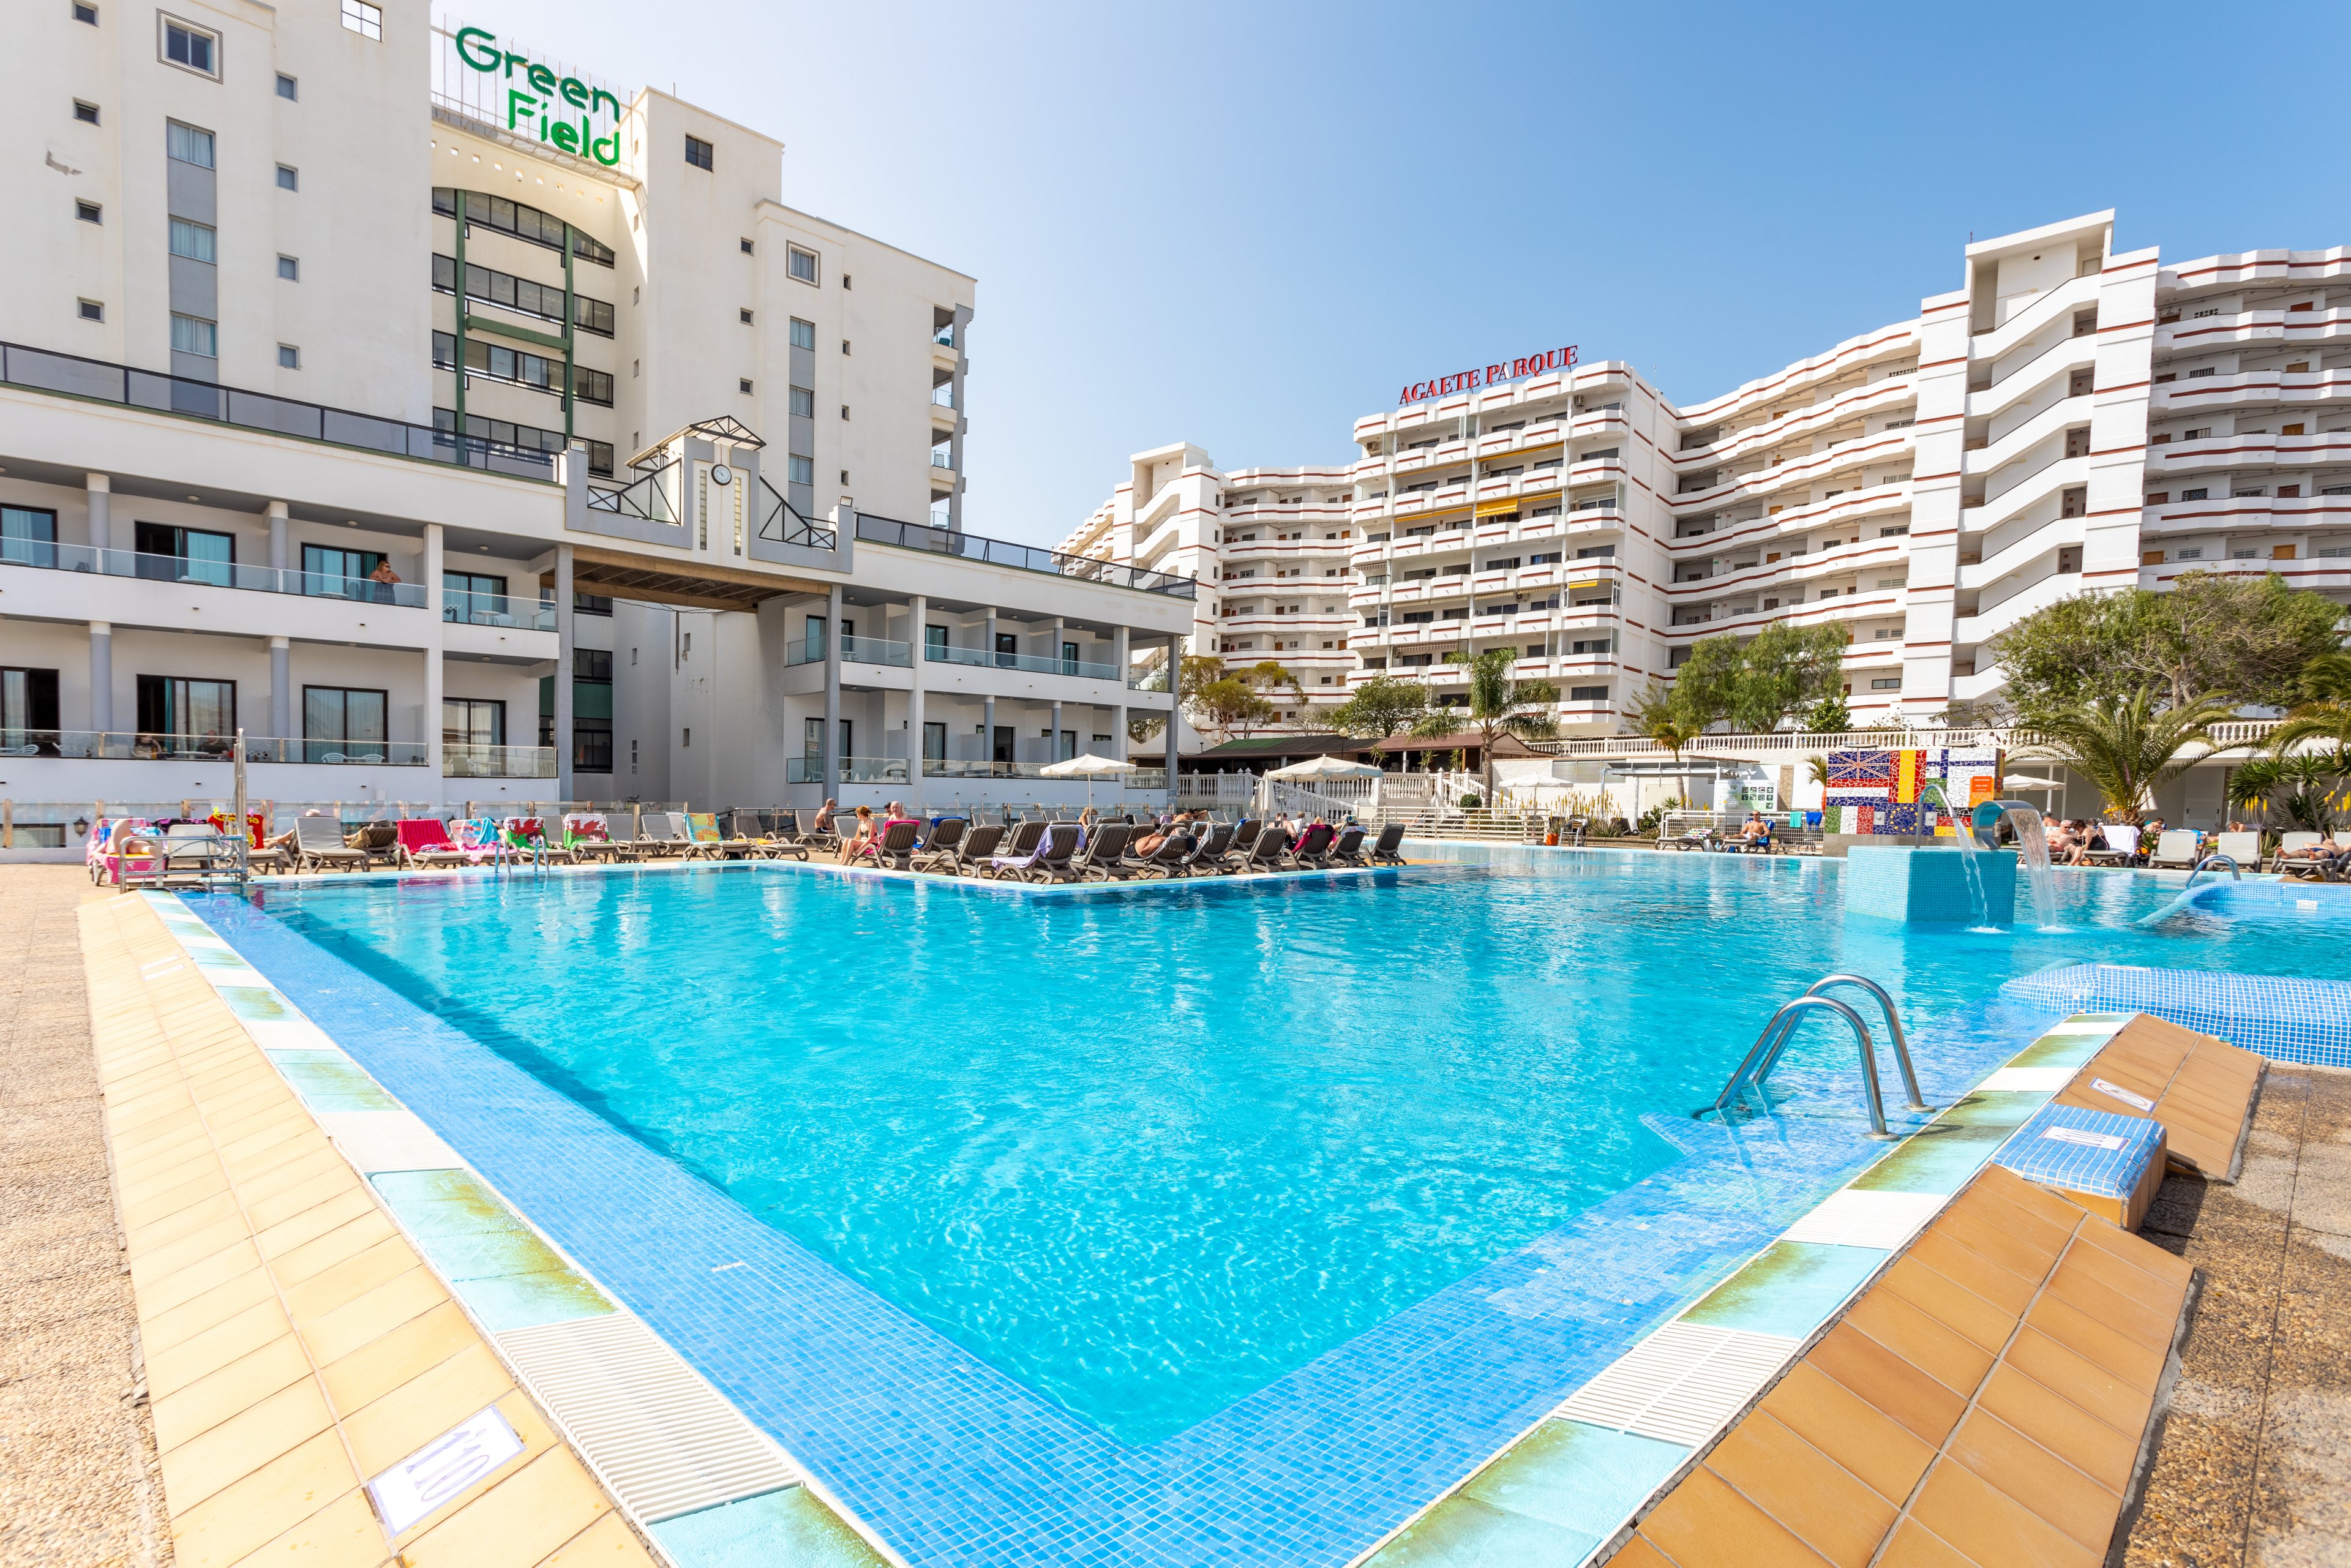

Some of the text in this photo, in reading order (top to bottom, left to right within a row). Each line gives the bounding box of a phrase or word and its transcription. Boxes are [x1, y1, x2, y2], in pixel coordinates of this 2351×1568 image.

[456, 27, 620, 123] Green
[508, 88, 620, 166] Field
[1399, 345, 1578, 405] AGAETE PARQUE
